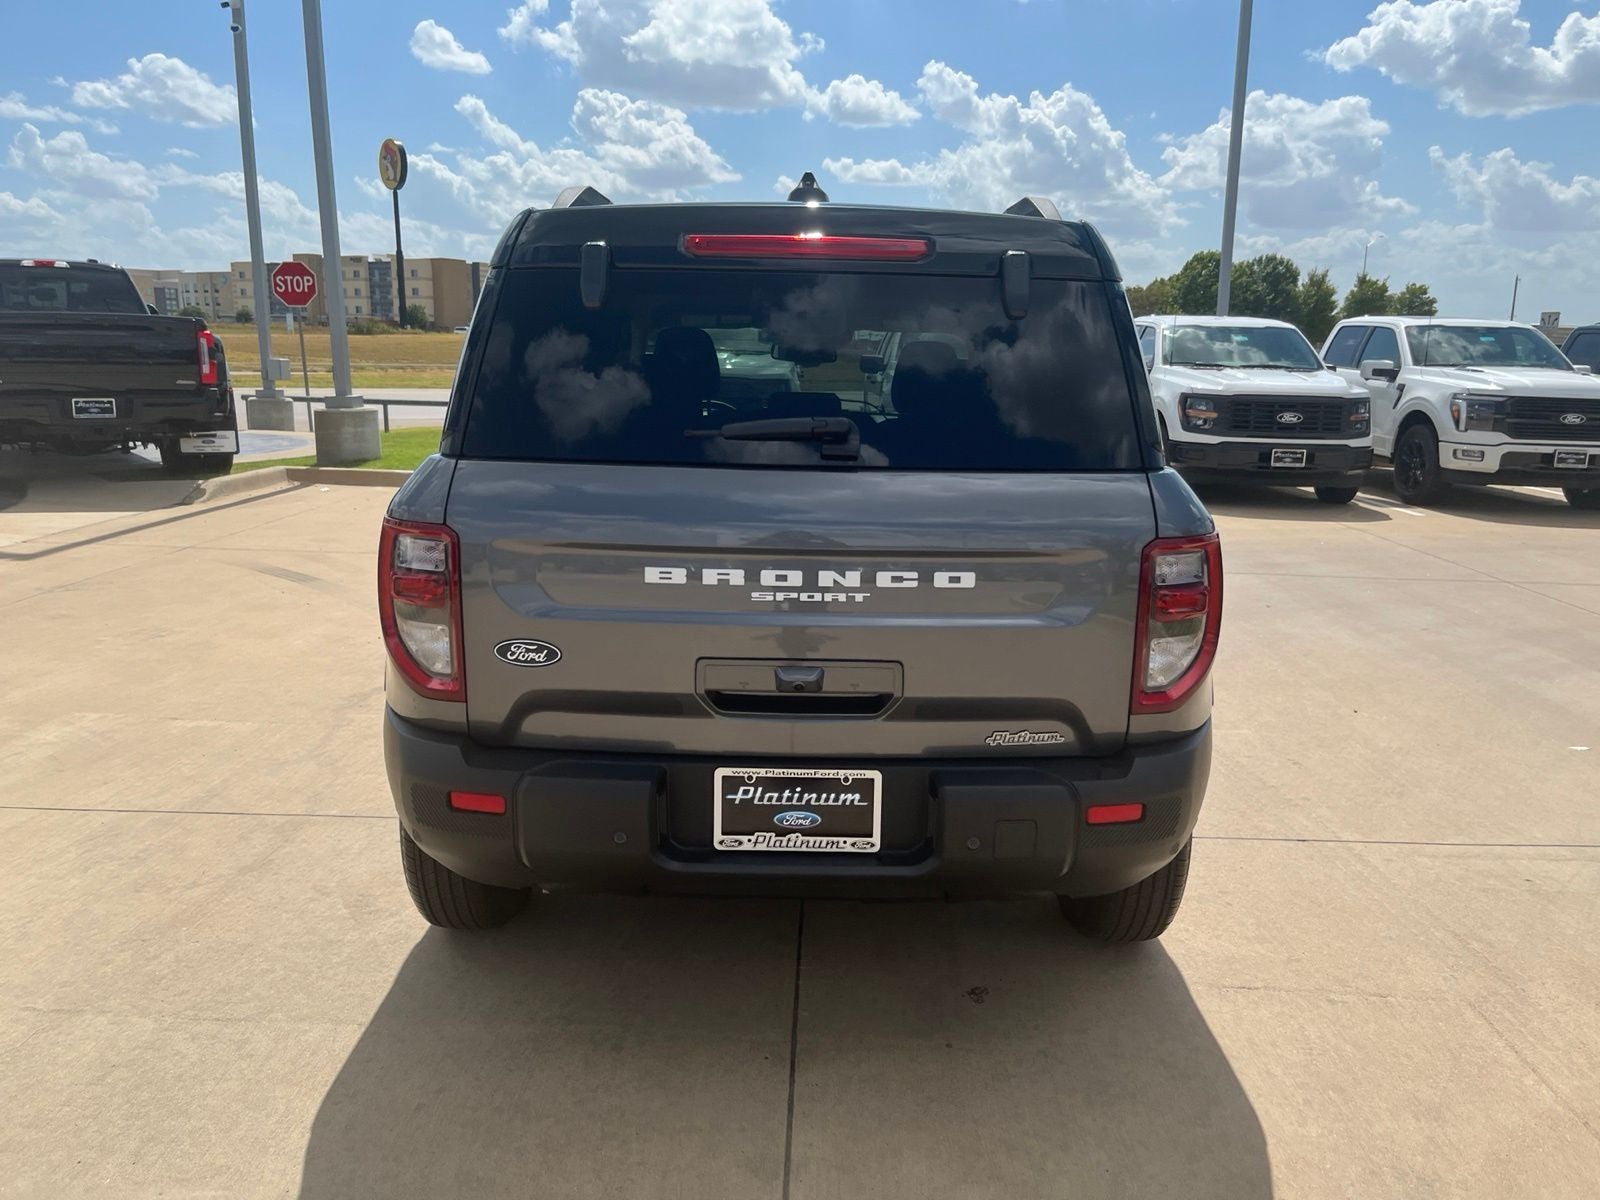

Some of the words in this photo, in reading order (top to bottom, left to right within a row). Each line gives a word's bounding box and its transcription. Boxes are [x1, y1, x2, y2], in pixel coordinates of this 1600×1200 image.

[276, 275, 313, 293] STOP
[644, 566, 976, 588] BRONCO
[751, 592, 870, 602] SPORT
[507, 643, 548, 661] Ford
[985, 731, 1065, 746] Platinum
[731, 769, 866, 777] www.PlatinumFord.com
[726, 786, 868, 806] Platinum
[783, 813, 812, 827] Ford
[752, 834, 846, 849] Platinum
